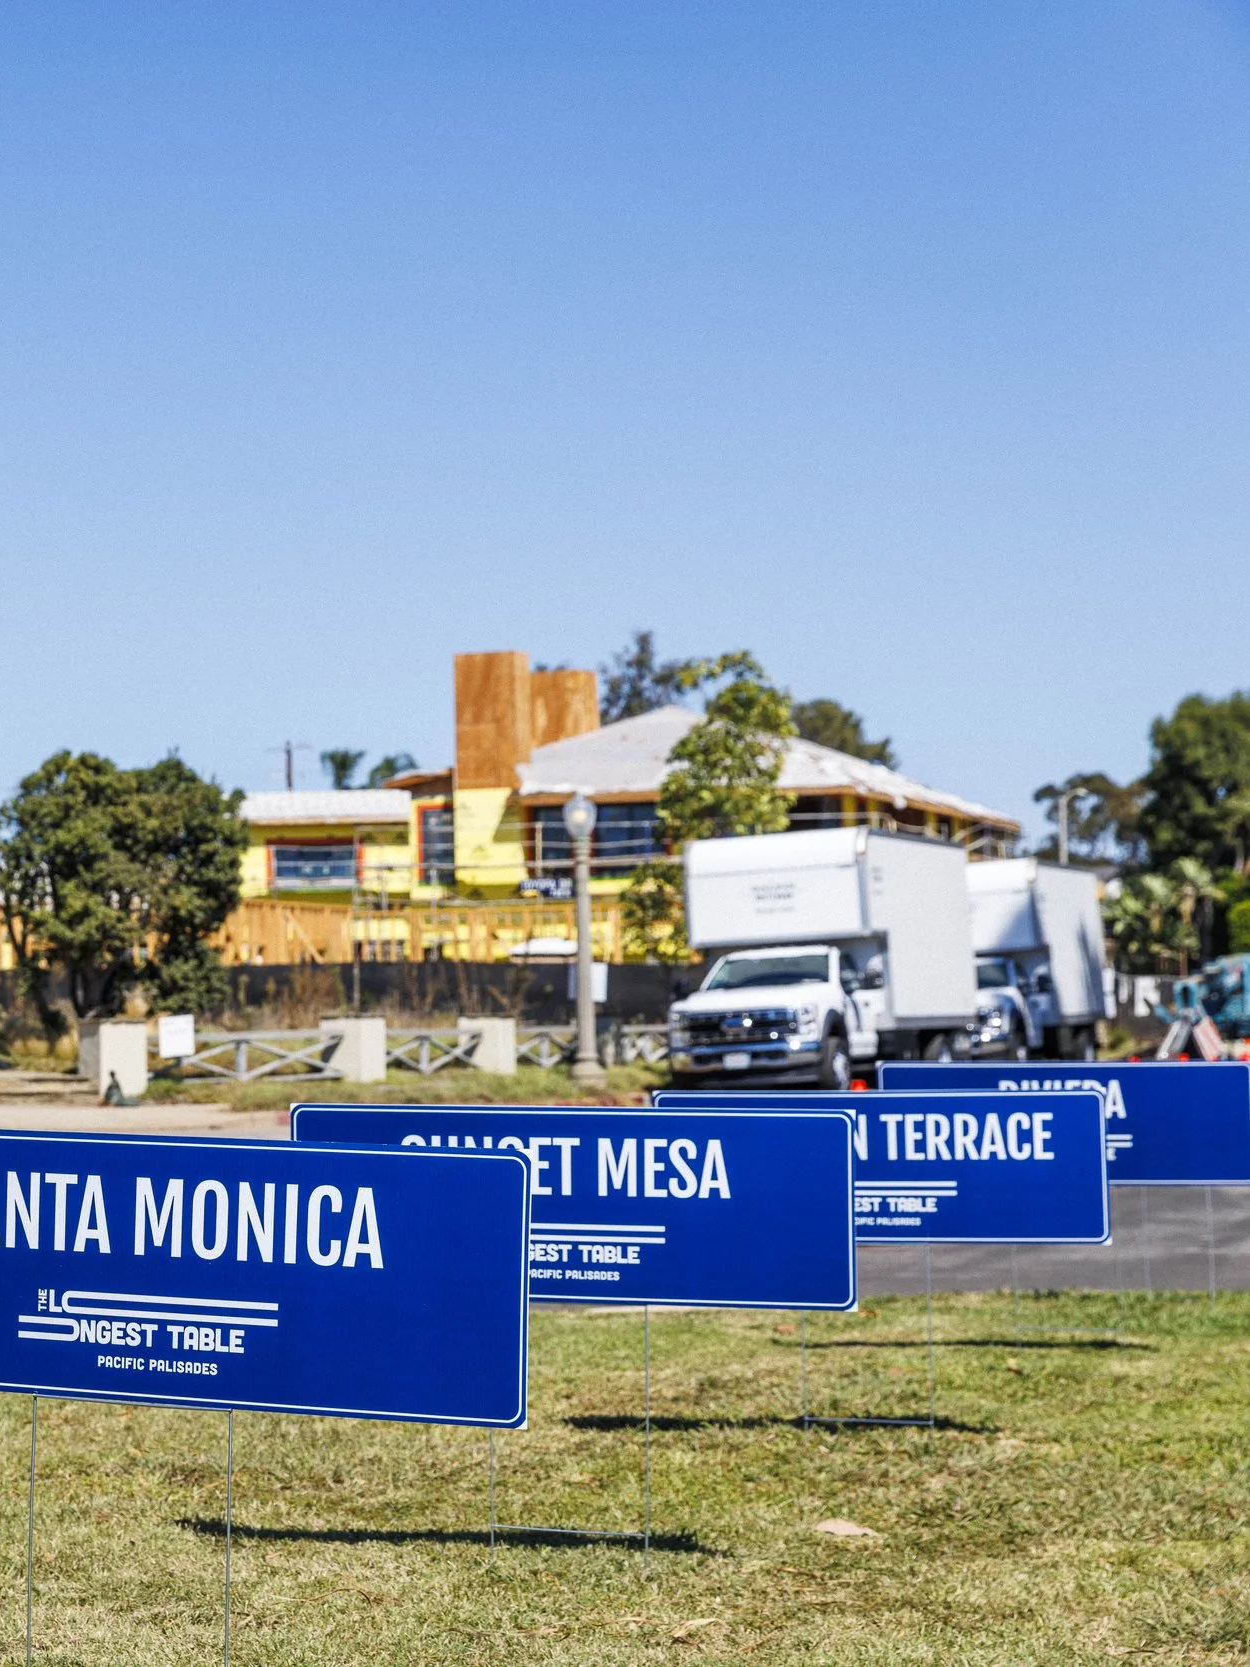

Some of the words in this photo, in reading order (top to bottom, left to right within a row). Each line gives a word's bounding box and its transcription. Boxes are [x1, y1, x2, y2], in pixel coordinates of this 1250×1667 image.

[879, 1112, 1055, 1161] TERRACE
[598, 1138, 731, 1199] MESA
[886, 1197, 938, 1213] TABLE
[135, 1177, 383, 1268] MONICA
[578, 1245, 640, 1264] TABLE
[529, 1269, 562, 1279] ACIFIC
[565, 1270, 620, 1281] PALISADES
[38, 1288, 48, 1312] THE
[167, 1325, 244, 1353] TABLE
[97, 1355, 145, 1371] PACIFIC
[149, 1358, 218, 1376] PALISADES
